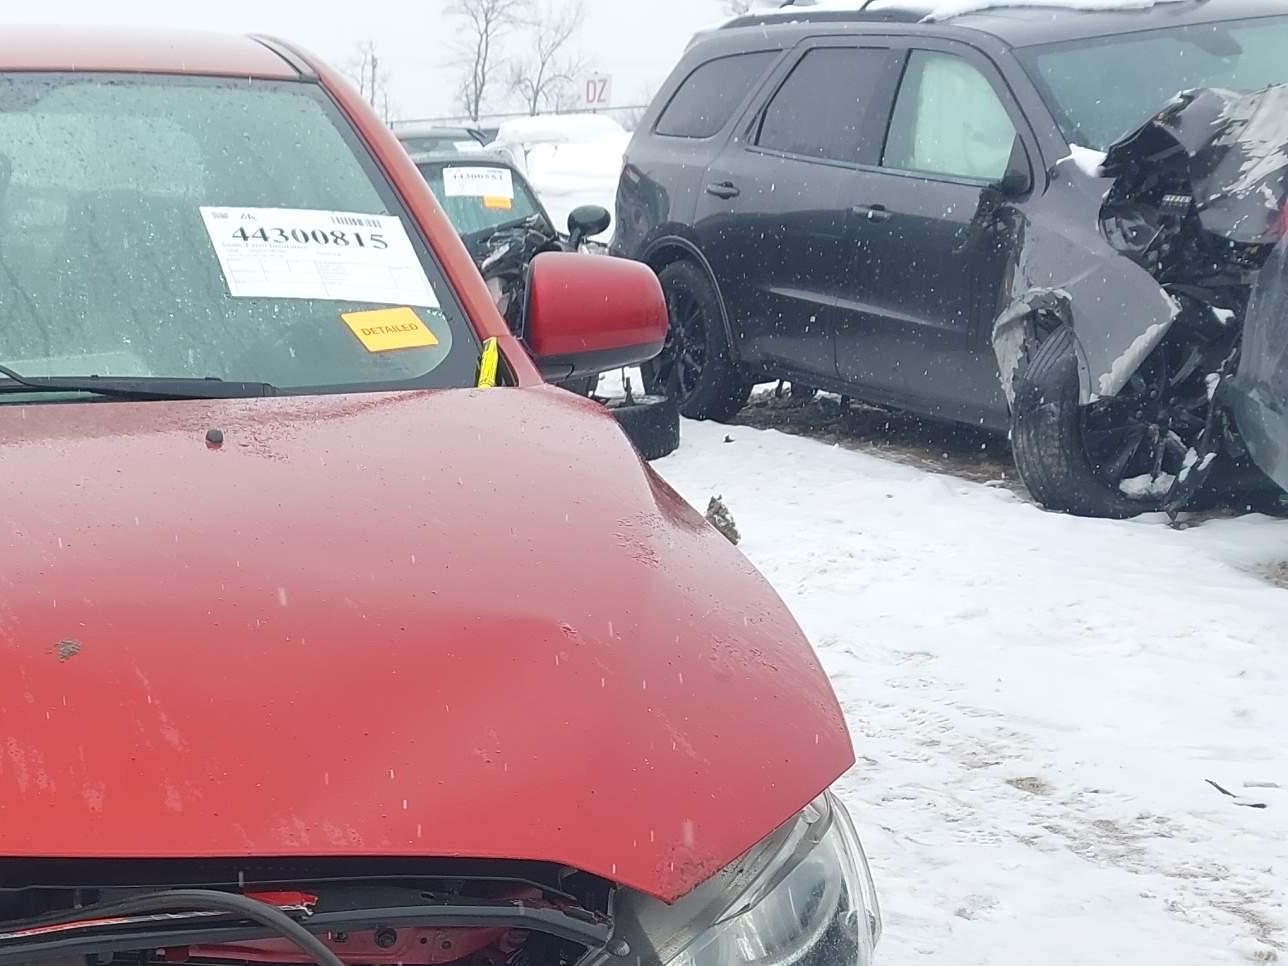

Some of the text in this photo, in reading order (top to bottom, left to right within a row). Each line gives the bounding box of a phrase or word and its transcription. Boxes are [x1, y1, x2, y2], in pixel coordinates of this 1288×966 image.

[586, 80, 608, 103] DZ
[232, 227, 388, 249] 44300815
[361, 323, 418, 336] DETAILED
